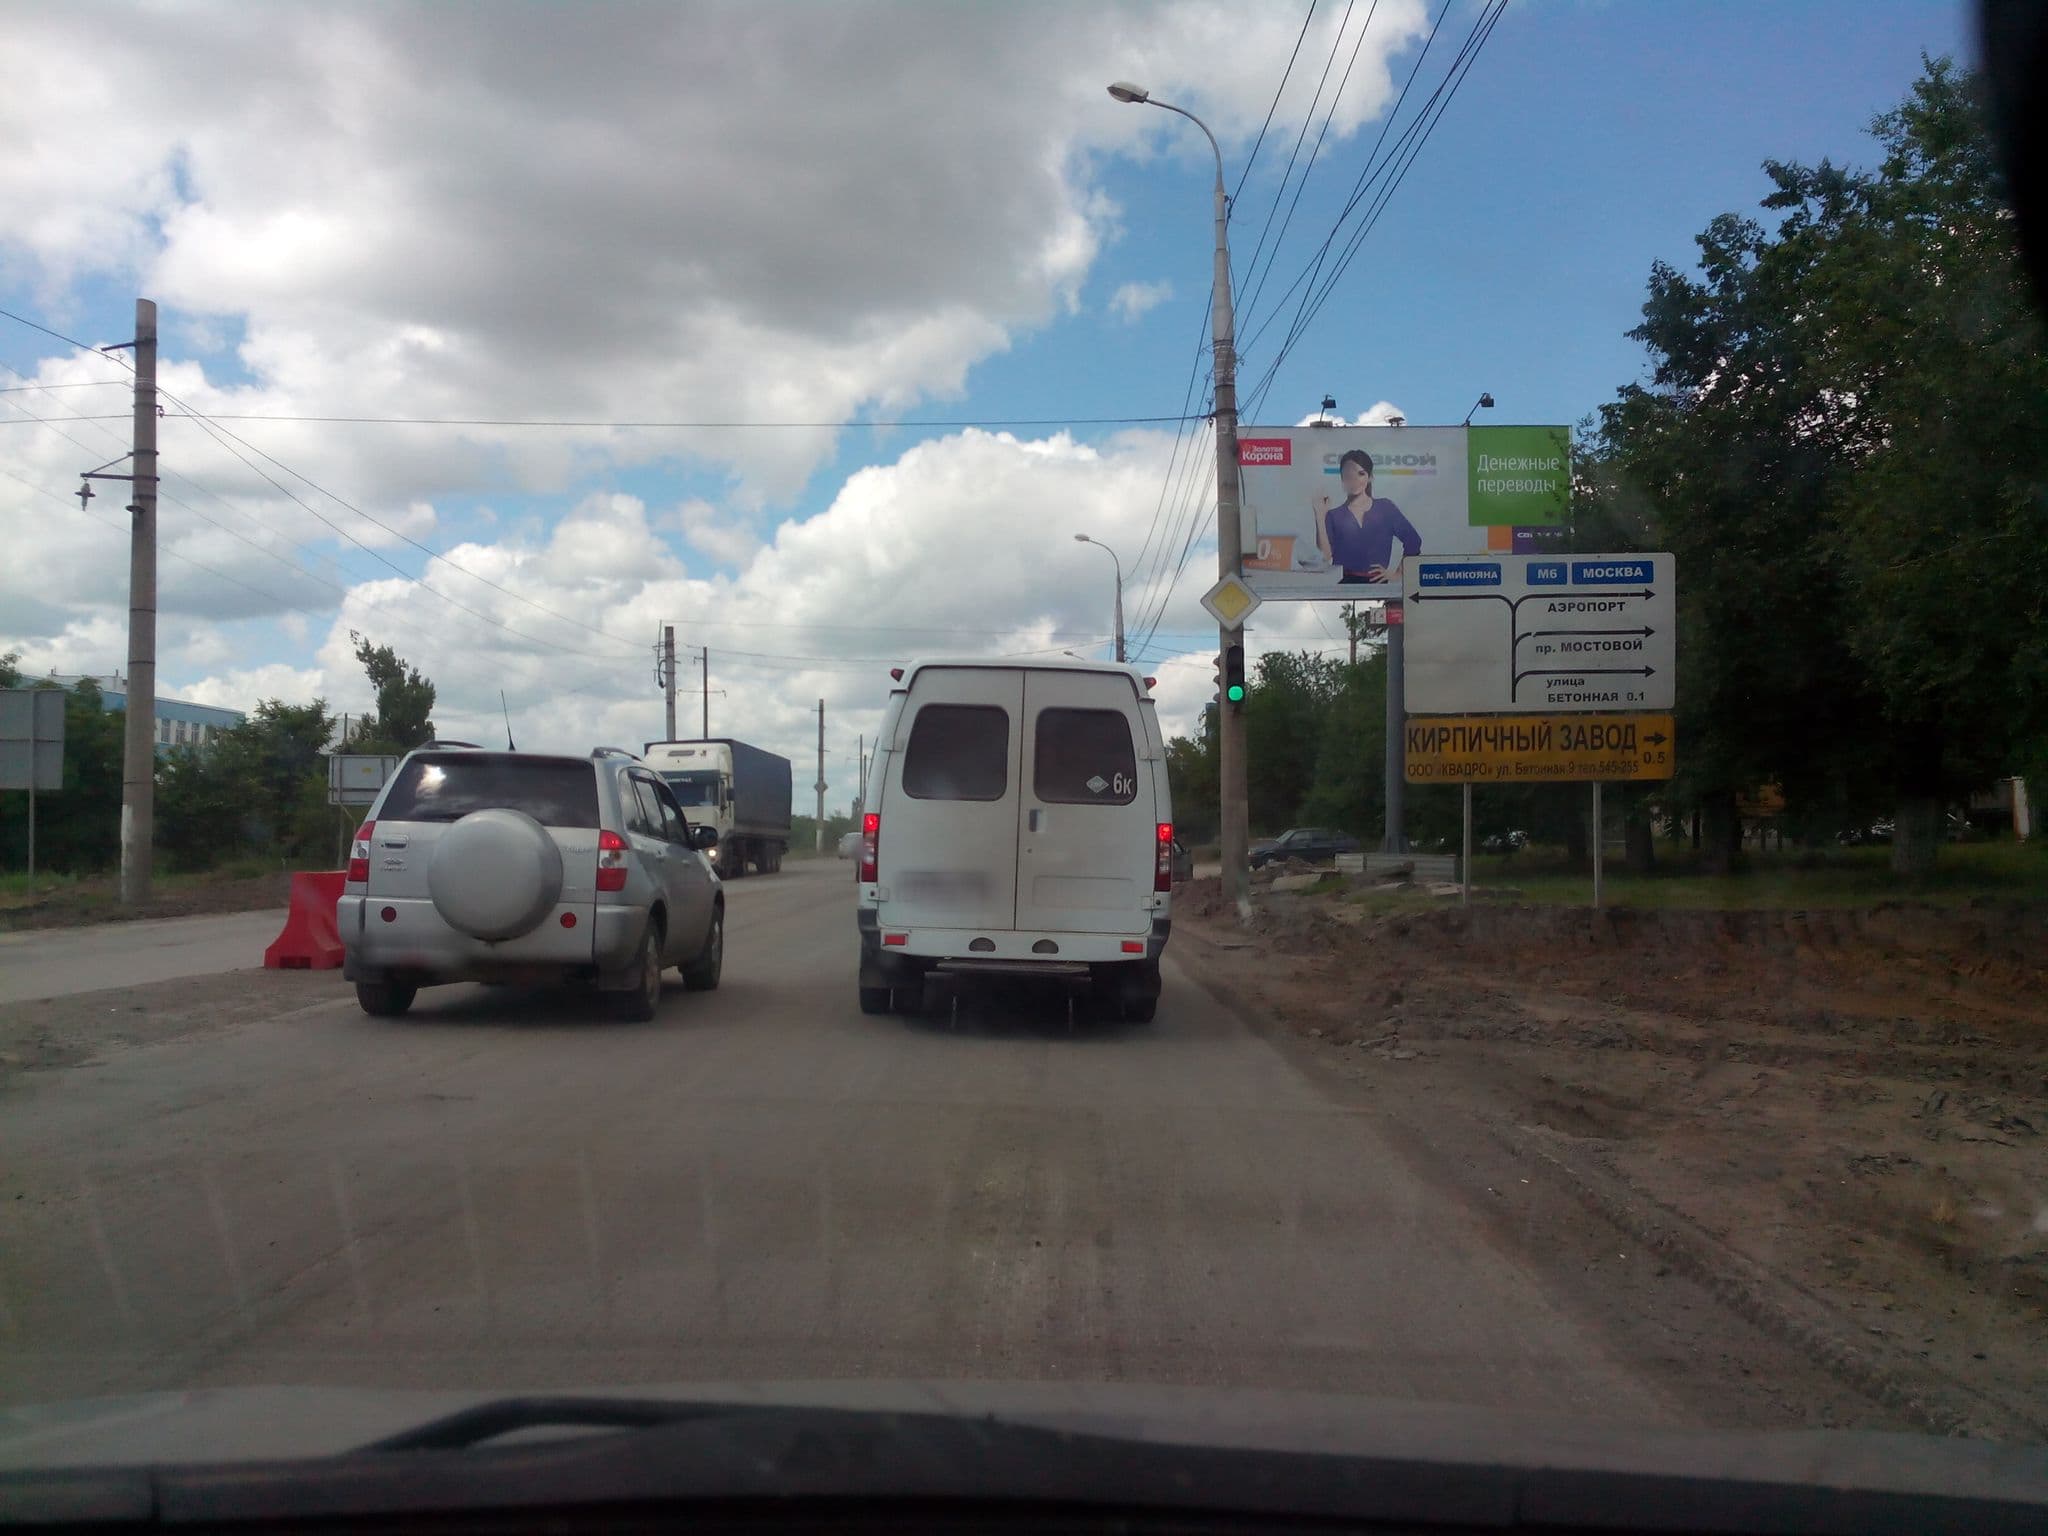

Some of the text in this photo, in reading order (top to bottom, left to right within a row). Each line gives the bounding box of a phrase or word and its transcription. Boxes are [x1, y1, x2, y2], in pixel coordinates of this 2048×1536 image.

[1242, 451, 1284, 462] Корона
[1323, 453, 1437, 466] СЗНОЙ
[1477, 454, 1560, 473] Денежные
[1478, 478, 1556, 496] переводы
[1422, 571, 1498, 580] пос. МИКОЯНА
[1537, 568, 1558, 579] М6
[1582, 567, 1644, 578] МОСКВА
[1547, 601, 1626, 613] АЭРОПОРТ
[1536, 638, 1643, 655] пр. МОСТОВОЙ
[1546, 677, 1585, 688] улица
[1547, 691, 1645, 703] БЕТОННАЯ 0.1
[1408, 720, 1638, 756] КИРПИЧНЫЙ ЗАВОД
[1643, 751, 1666, 765] 0.5
[1408, 763, 1433, 777] ООО
[1496, 764, 1512, 779] ул.
